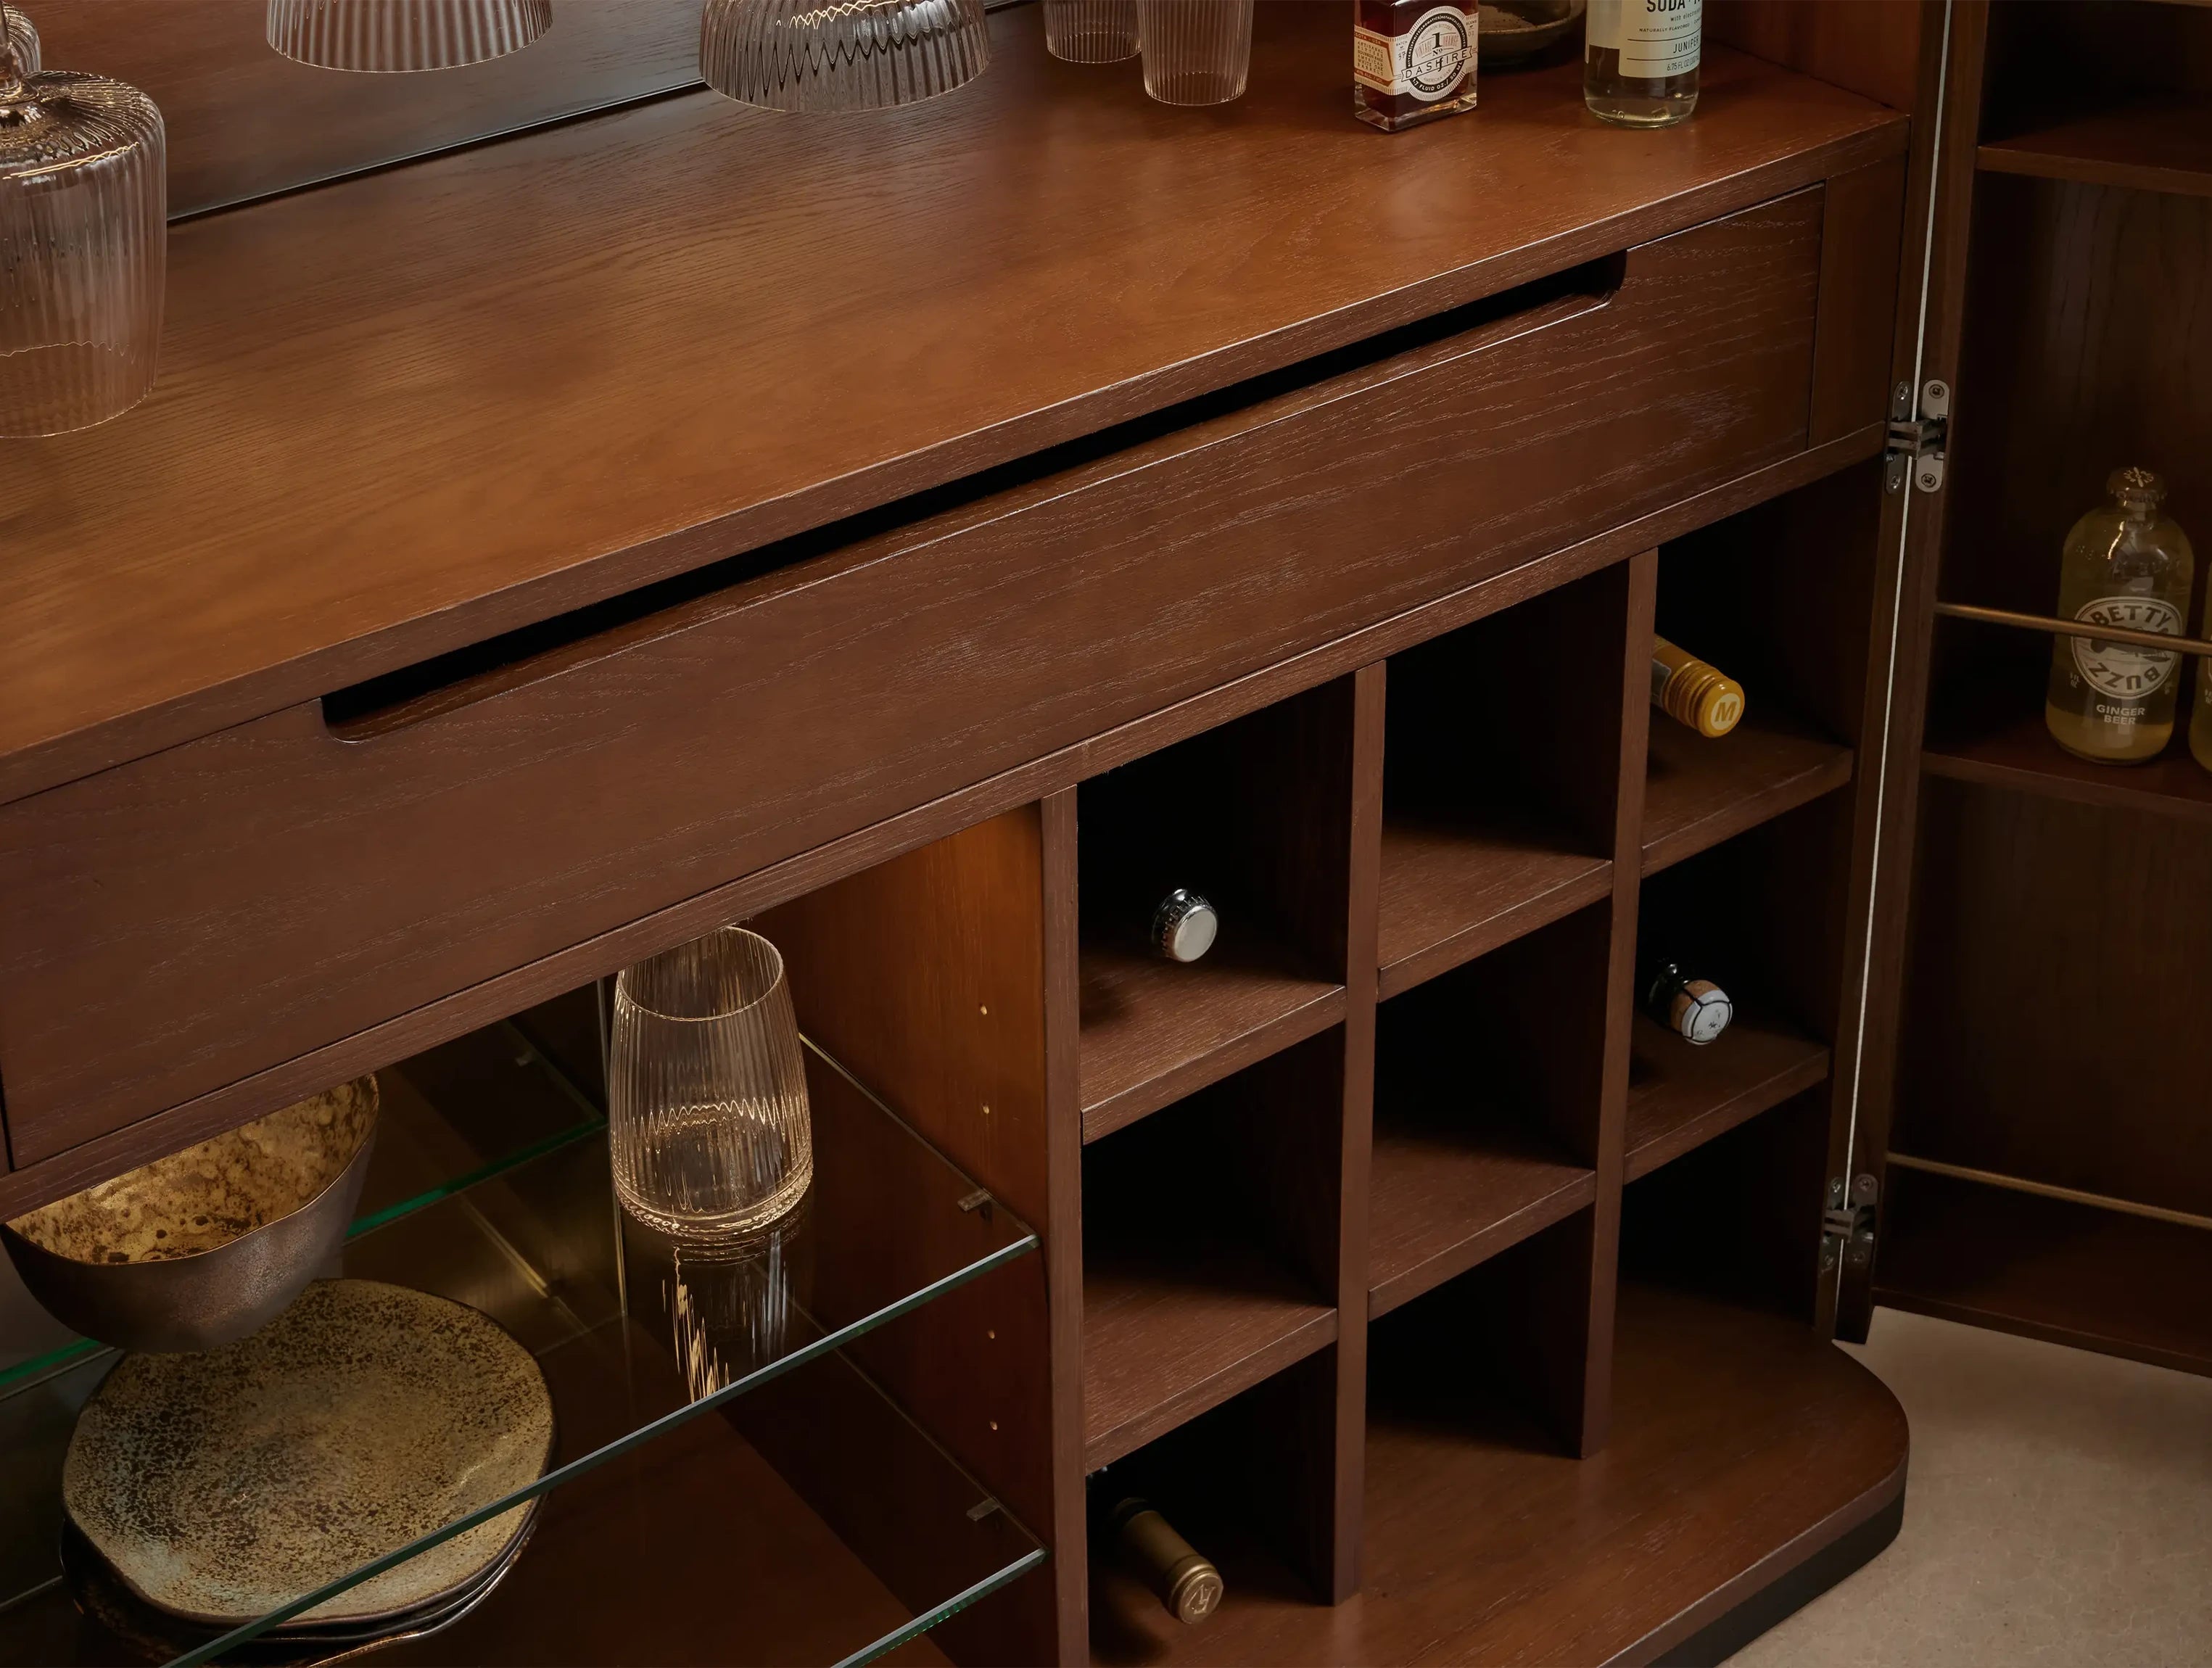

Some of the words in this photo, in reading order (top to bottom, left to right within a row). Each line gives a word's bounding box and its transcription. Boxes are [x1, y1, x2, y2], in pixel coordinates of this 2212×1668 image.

[1647, 0, 1685, 12] SODA
[1432, 32, 1443, 49] 1
[1673, 35, 1699, 54] JUNIPER
[1456, 60, 1463, 70] ML
[2089, 605, 2171, 628] BETTY
[2088, 662, 2161, 690] BUZZ
[1714, 701, 1737, 722] M
[2096, 704, 2145, 717] GINGER
[2104, 714, 2137, 725] BEER
